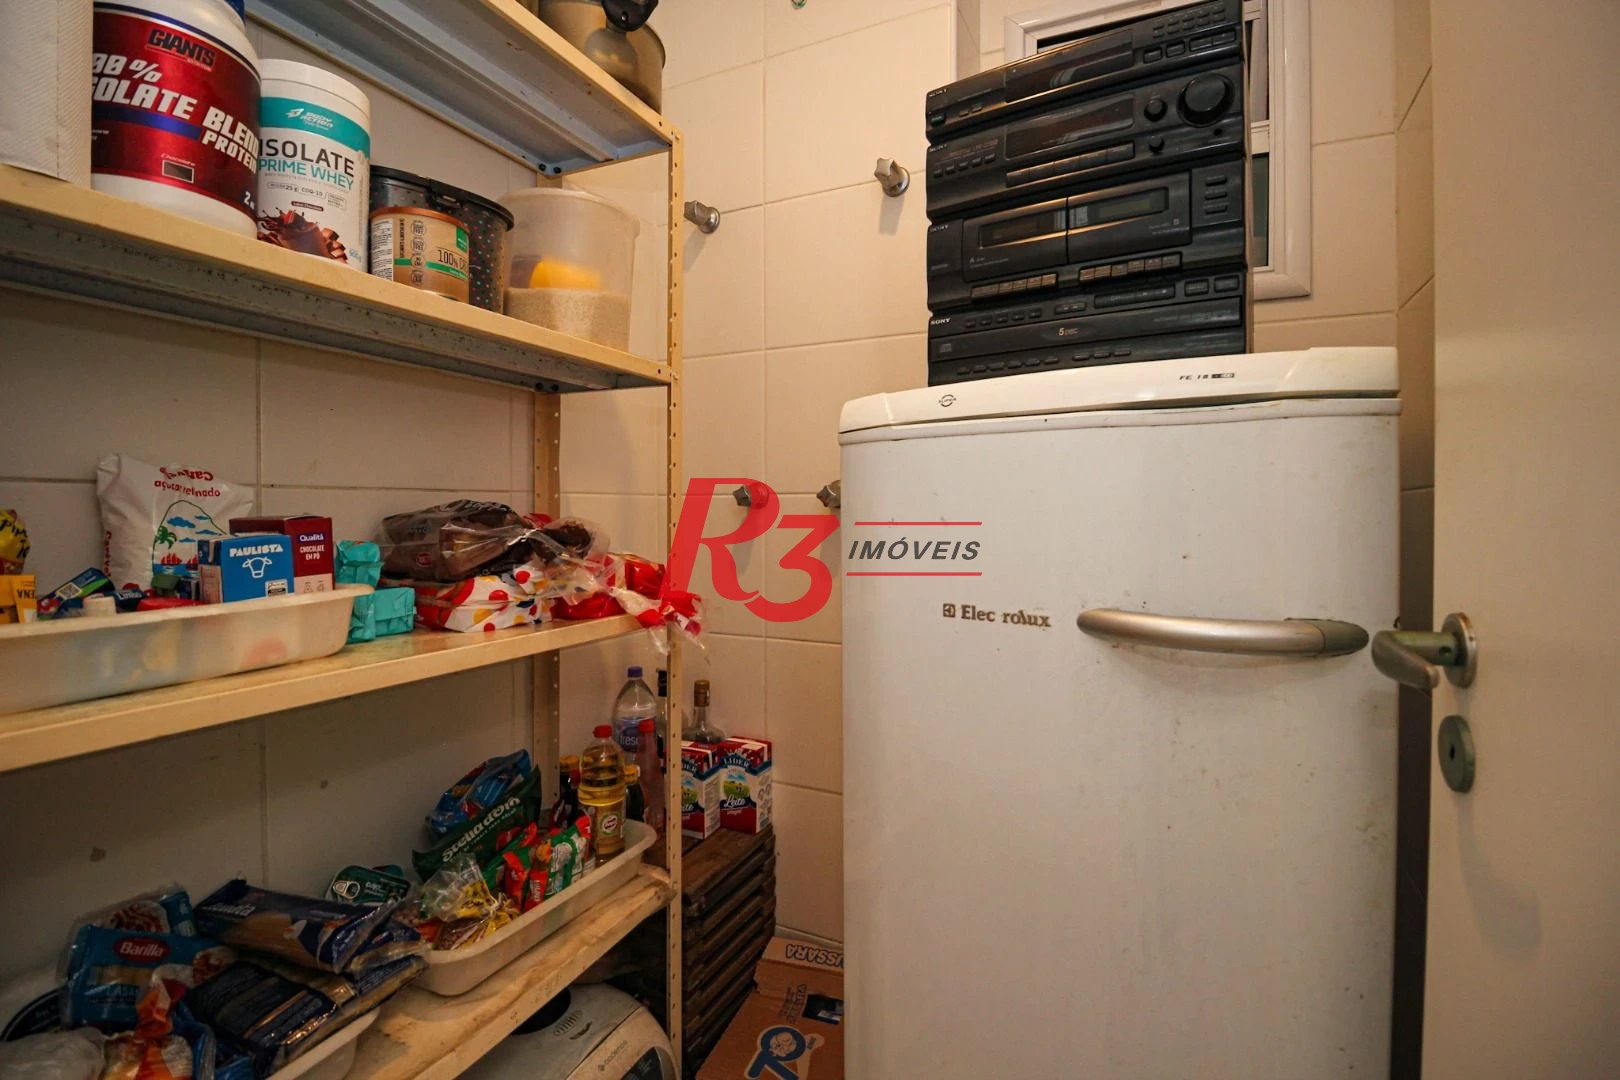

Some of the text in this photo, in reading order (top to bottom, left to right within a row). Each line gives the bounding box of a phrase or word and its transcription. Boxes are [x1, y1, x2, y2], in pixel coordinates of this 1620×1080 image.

[149, 28, 215, 66] GIANTS
[92, 77, 198, 120] OLATE
[259, 139, 354, 178] ISOLATE
[259, 159, 307, 176] PRIME
[310, 164, 354, 191] WHEY
[930, 317, 951, 326] SONY
[1058, 327, 1065, 337] 5
[229, 543, 284, 558] PAULISTA
[299, 545, 325, 554] CHOCOLATE
[119, 941, 164, 958] Barilla
